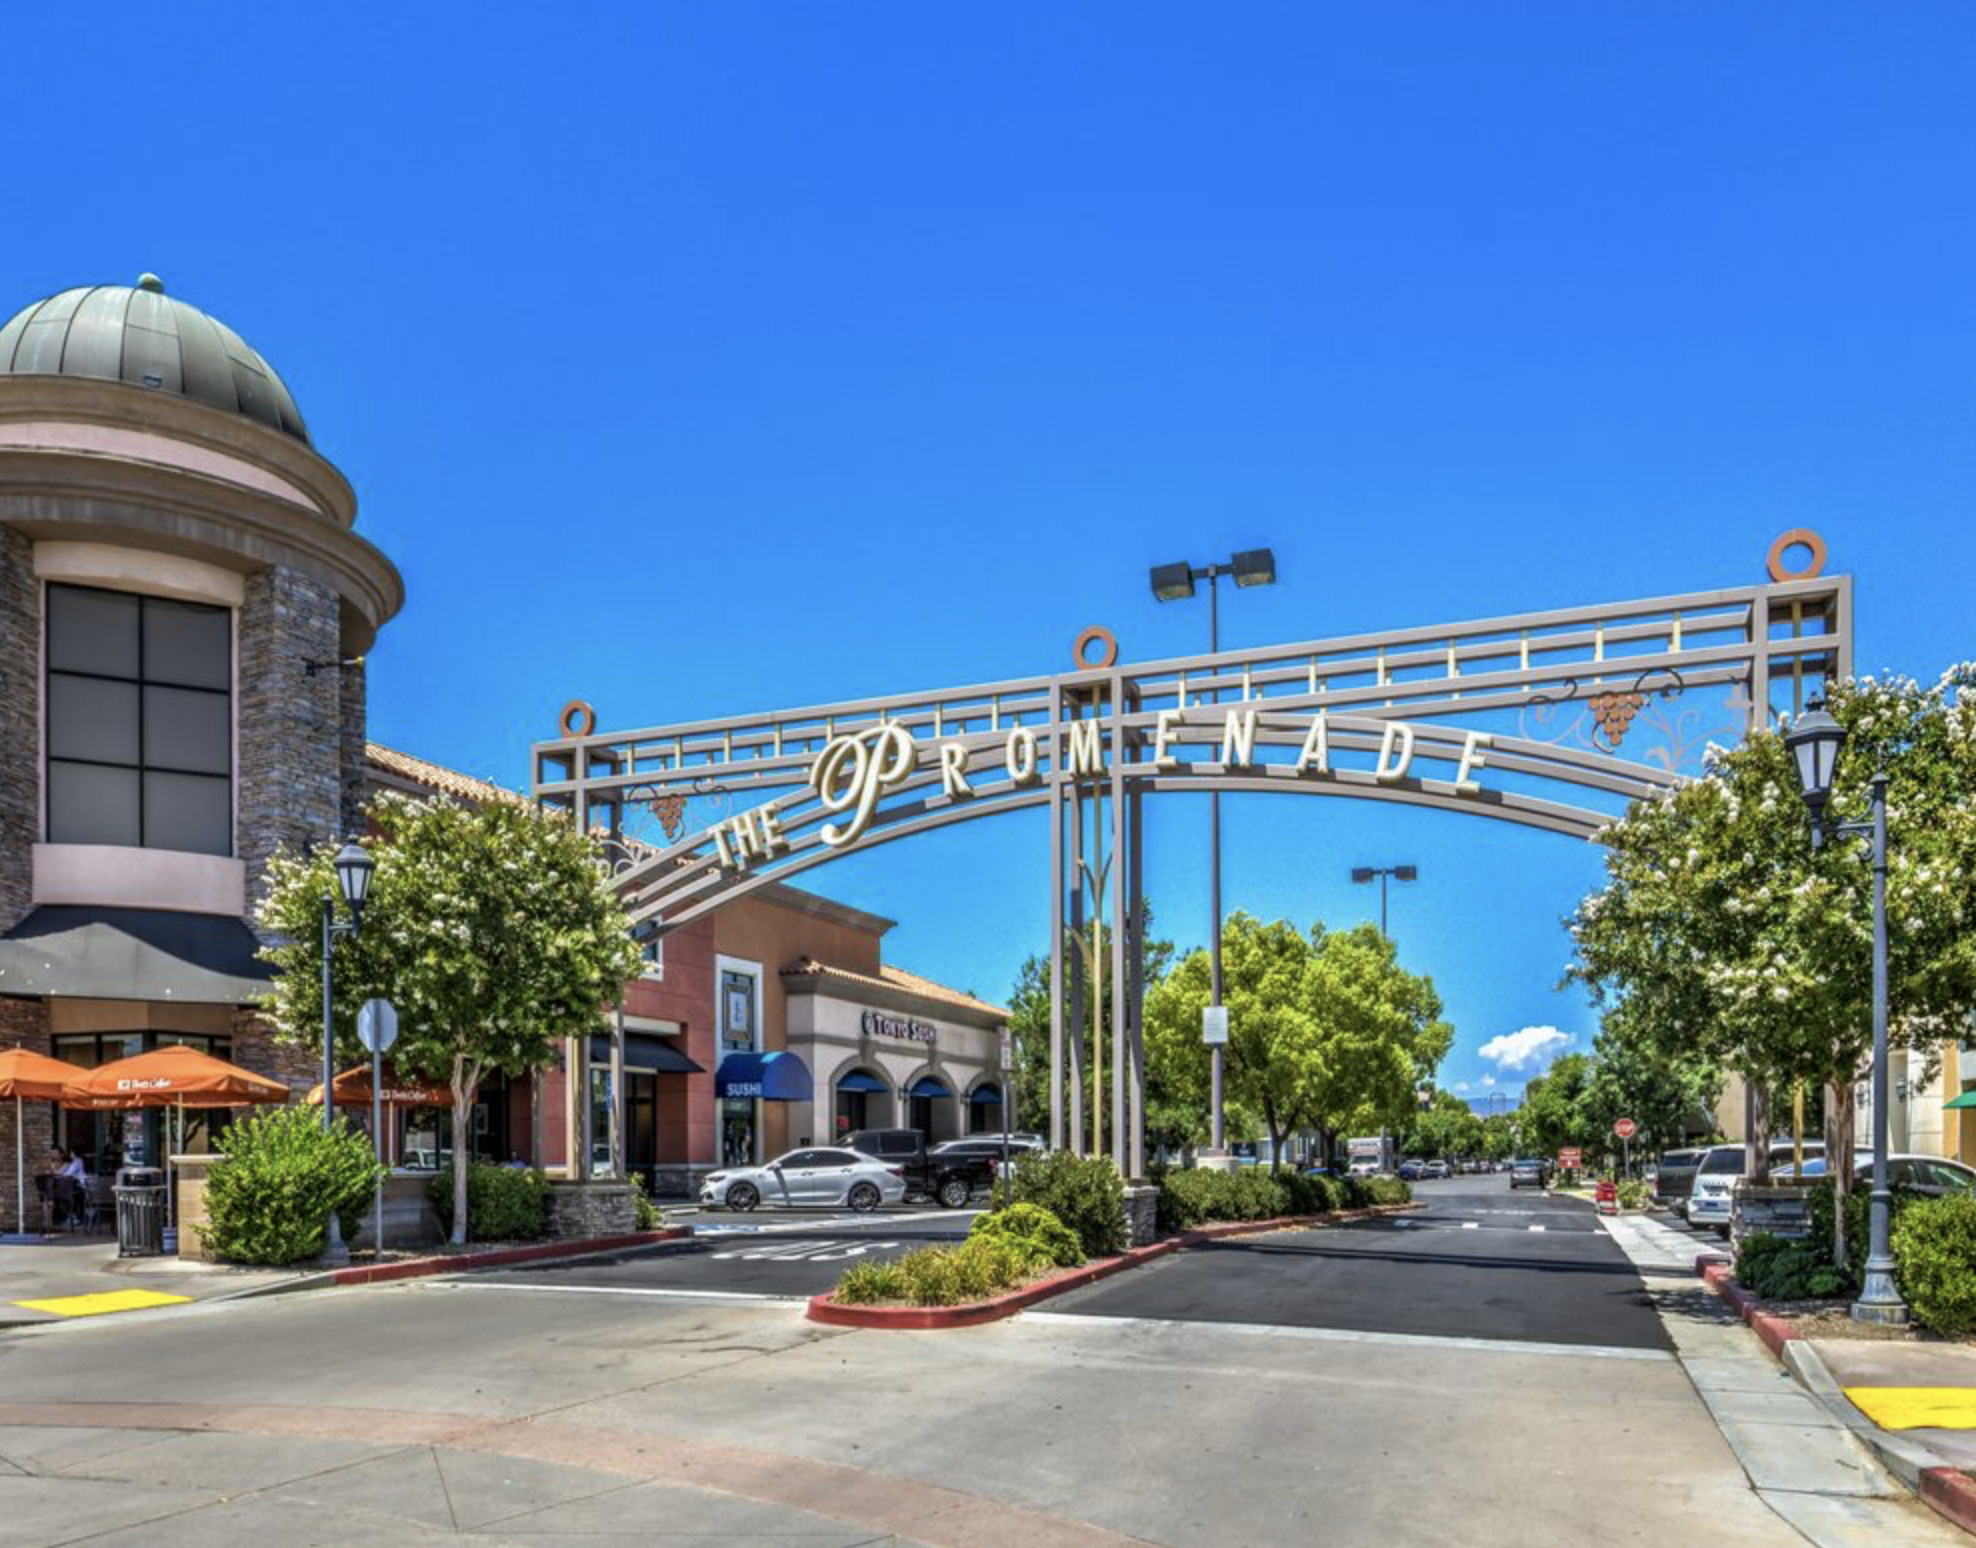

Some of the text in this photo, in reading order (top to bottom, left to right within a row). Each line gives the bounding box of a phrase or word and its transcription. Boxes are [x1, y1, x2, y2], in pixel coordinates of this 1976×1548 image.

[707, 708, 1494, 870] THE PROMENADE
[726, 1083, 762, 1097] SUSHI
